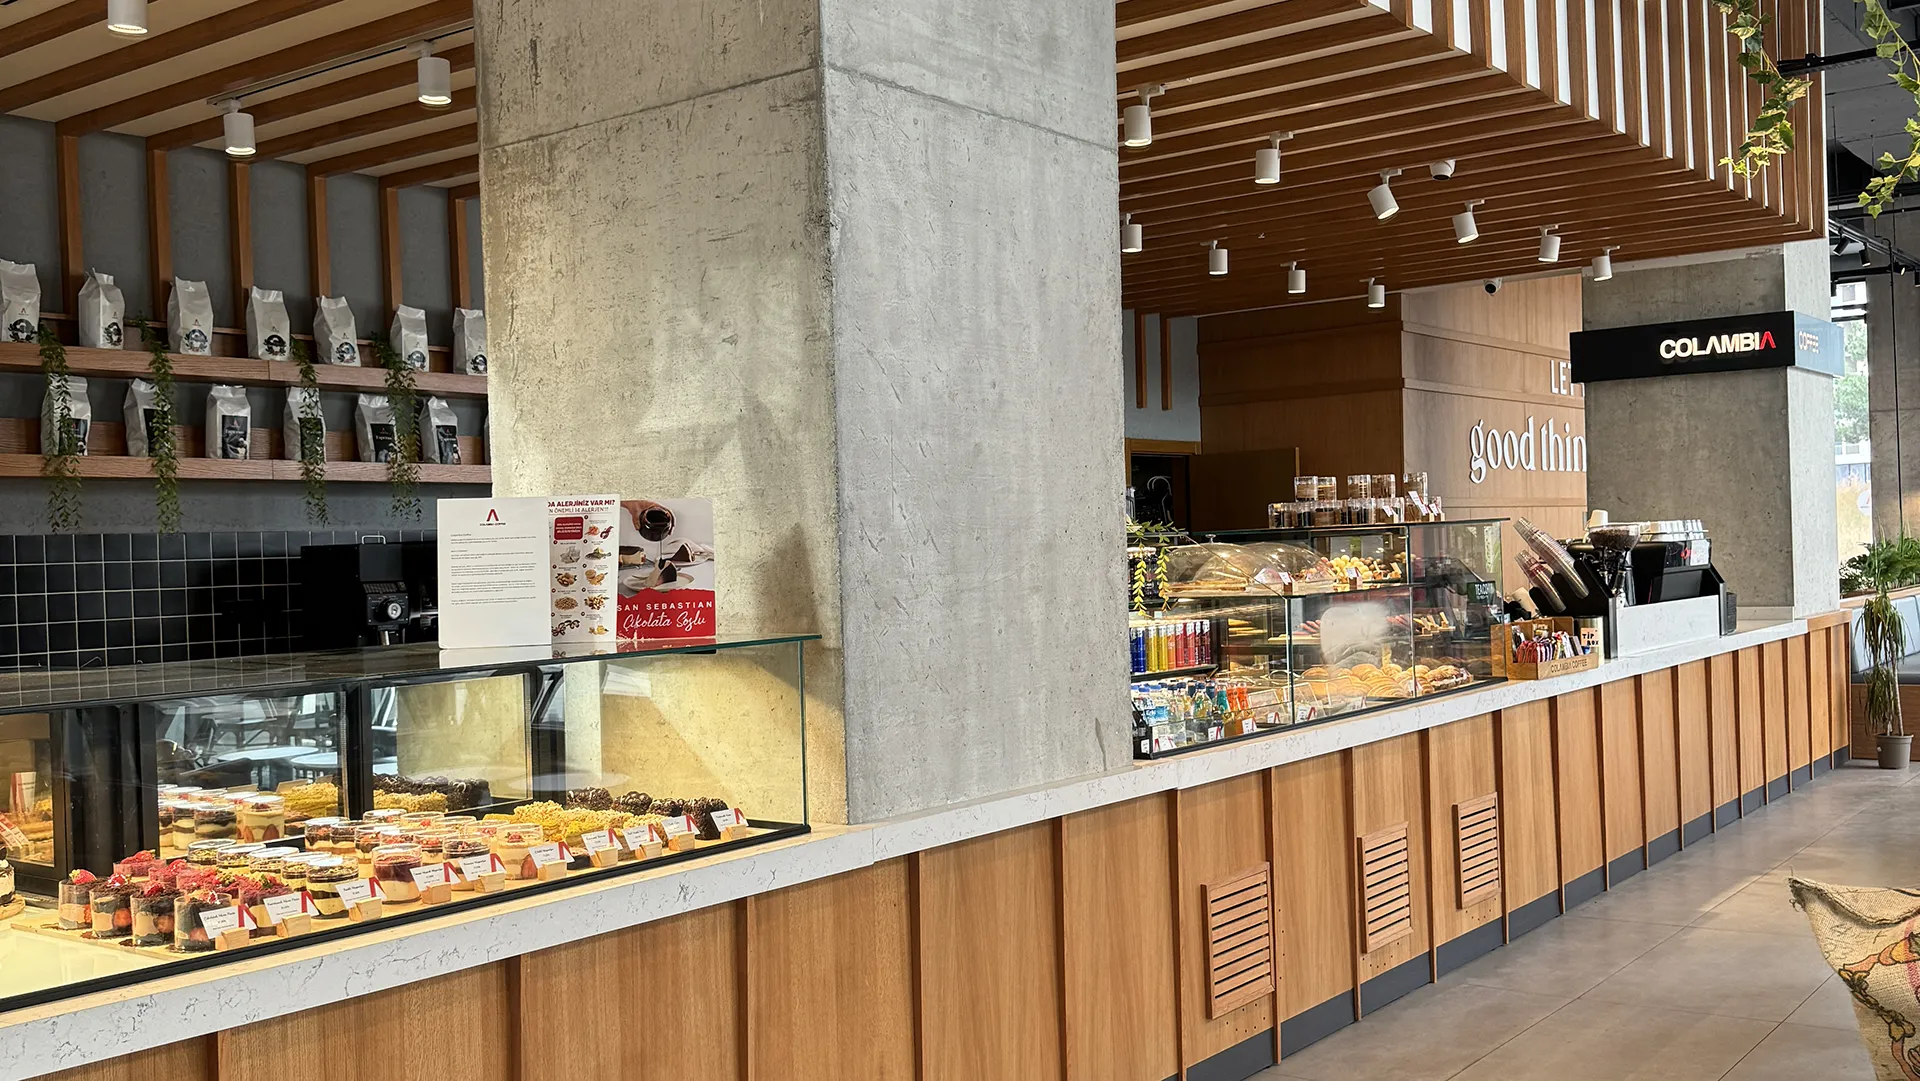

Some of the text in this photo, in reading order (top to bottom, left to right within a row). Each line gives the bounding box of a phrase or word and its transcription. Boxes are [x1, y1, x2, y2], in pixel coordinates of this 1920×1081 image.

[1660, 331, 1776, 359] COLAMBIA
[1469, 416, 1536, 484] good
[646, 601, 712, 611] SEBASTIAN
[623, 612, 672, 631] Çikolata
